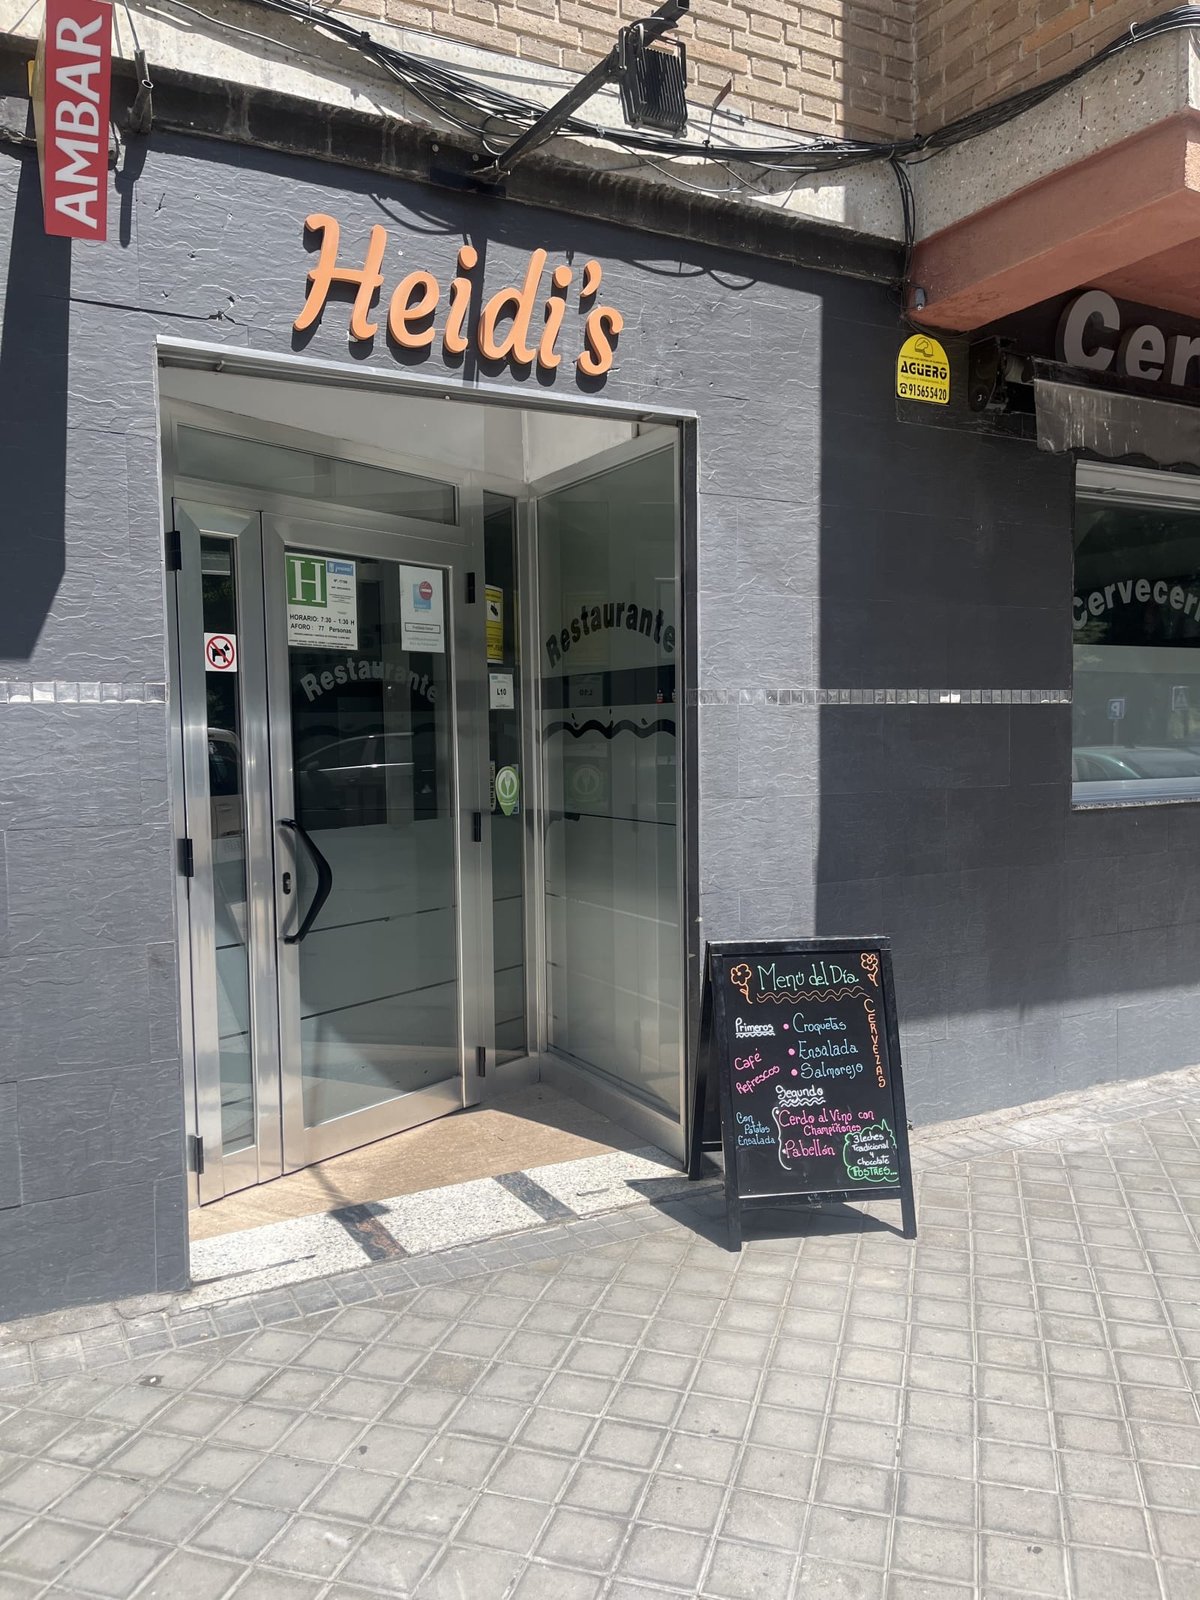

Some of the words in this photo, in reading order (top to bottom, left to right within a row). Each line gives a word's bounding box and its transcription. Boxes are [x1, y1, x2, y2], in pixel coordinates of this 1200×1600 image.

[55, 15, 103, 229] AMBAR
[293, 213, 624, 377] Heidi's
[901, 361, 947, 380] AGÜERO
[909, 383, 947, 401] 915655420
[289, 559, 326, 604] H
[290, 614, 319, 622] HORARIO:
[328, 626, 352, 634] Personas
[546, 602, 676, 668] Restaurante
[300, 657, 440, 703] Restaurante
[809, 961, 829, 986] del
[735, 1017, 774, 1033] Primeros
[792, 1012, 847, 1035] Croquetas
[798, 1039, 858, 1060] Ensalada
[863, 998, 886, 1088] CERVEZAS
[734, 1048, 762, 1071] Café
[736, 1065, 780, 1095] Refrescos
[800, 1062, 863, 1080] Salmorejo
[775, 1085, 824, 1102] Segundo
[736, 1112, 753, 1124] Con
[779, 1109, 815, 1127] Cerdo
[818, 1107, 828, 1123] al
[829, 1109, 852, 1125] Vino
[858, 1110, 875, 1120] con
[737, 1134, 776, 1146] Ensalada
[784, 1138, 836, 1159] Pabellón
[851, 1140, 889, 1152] Tradicional
